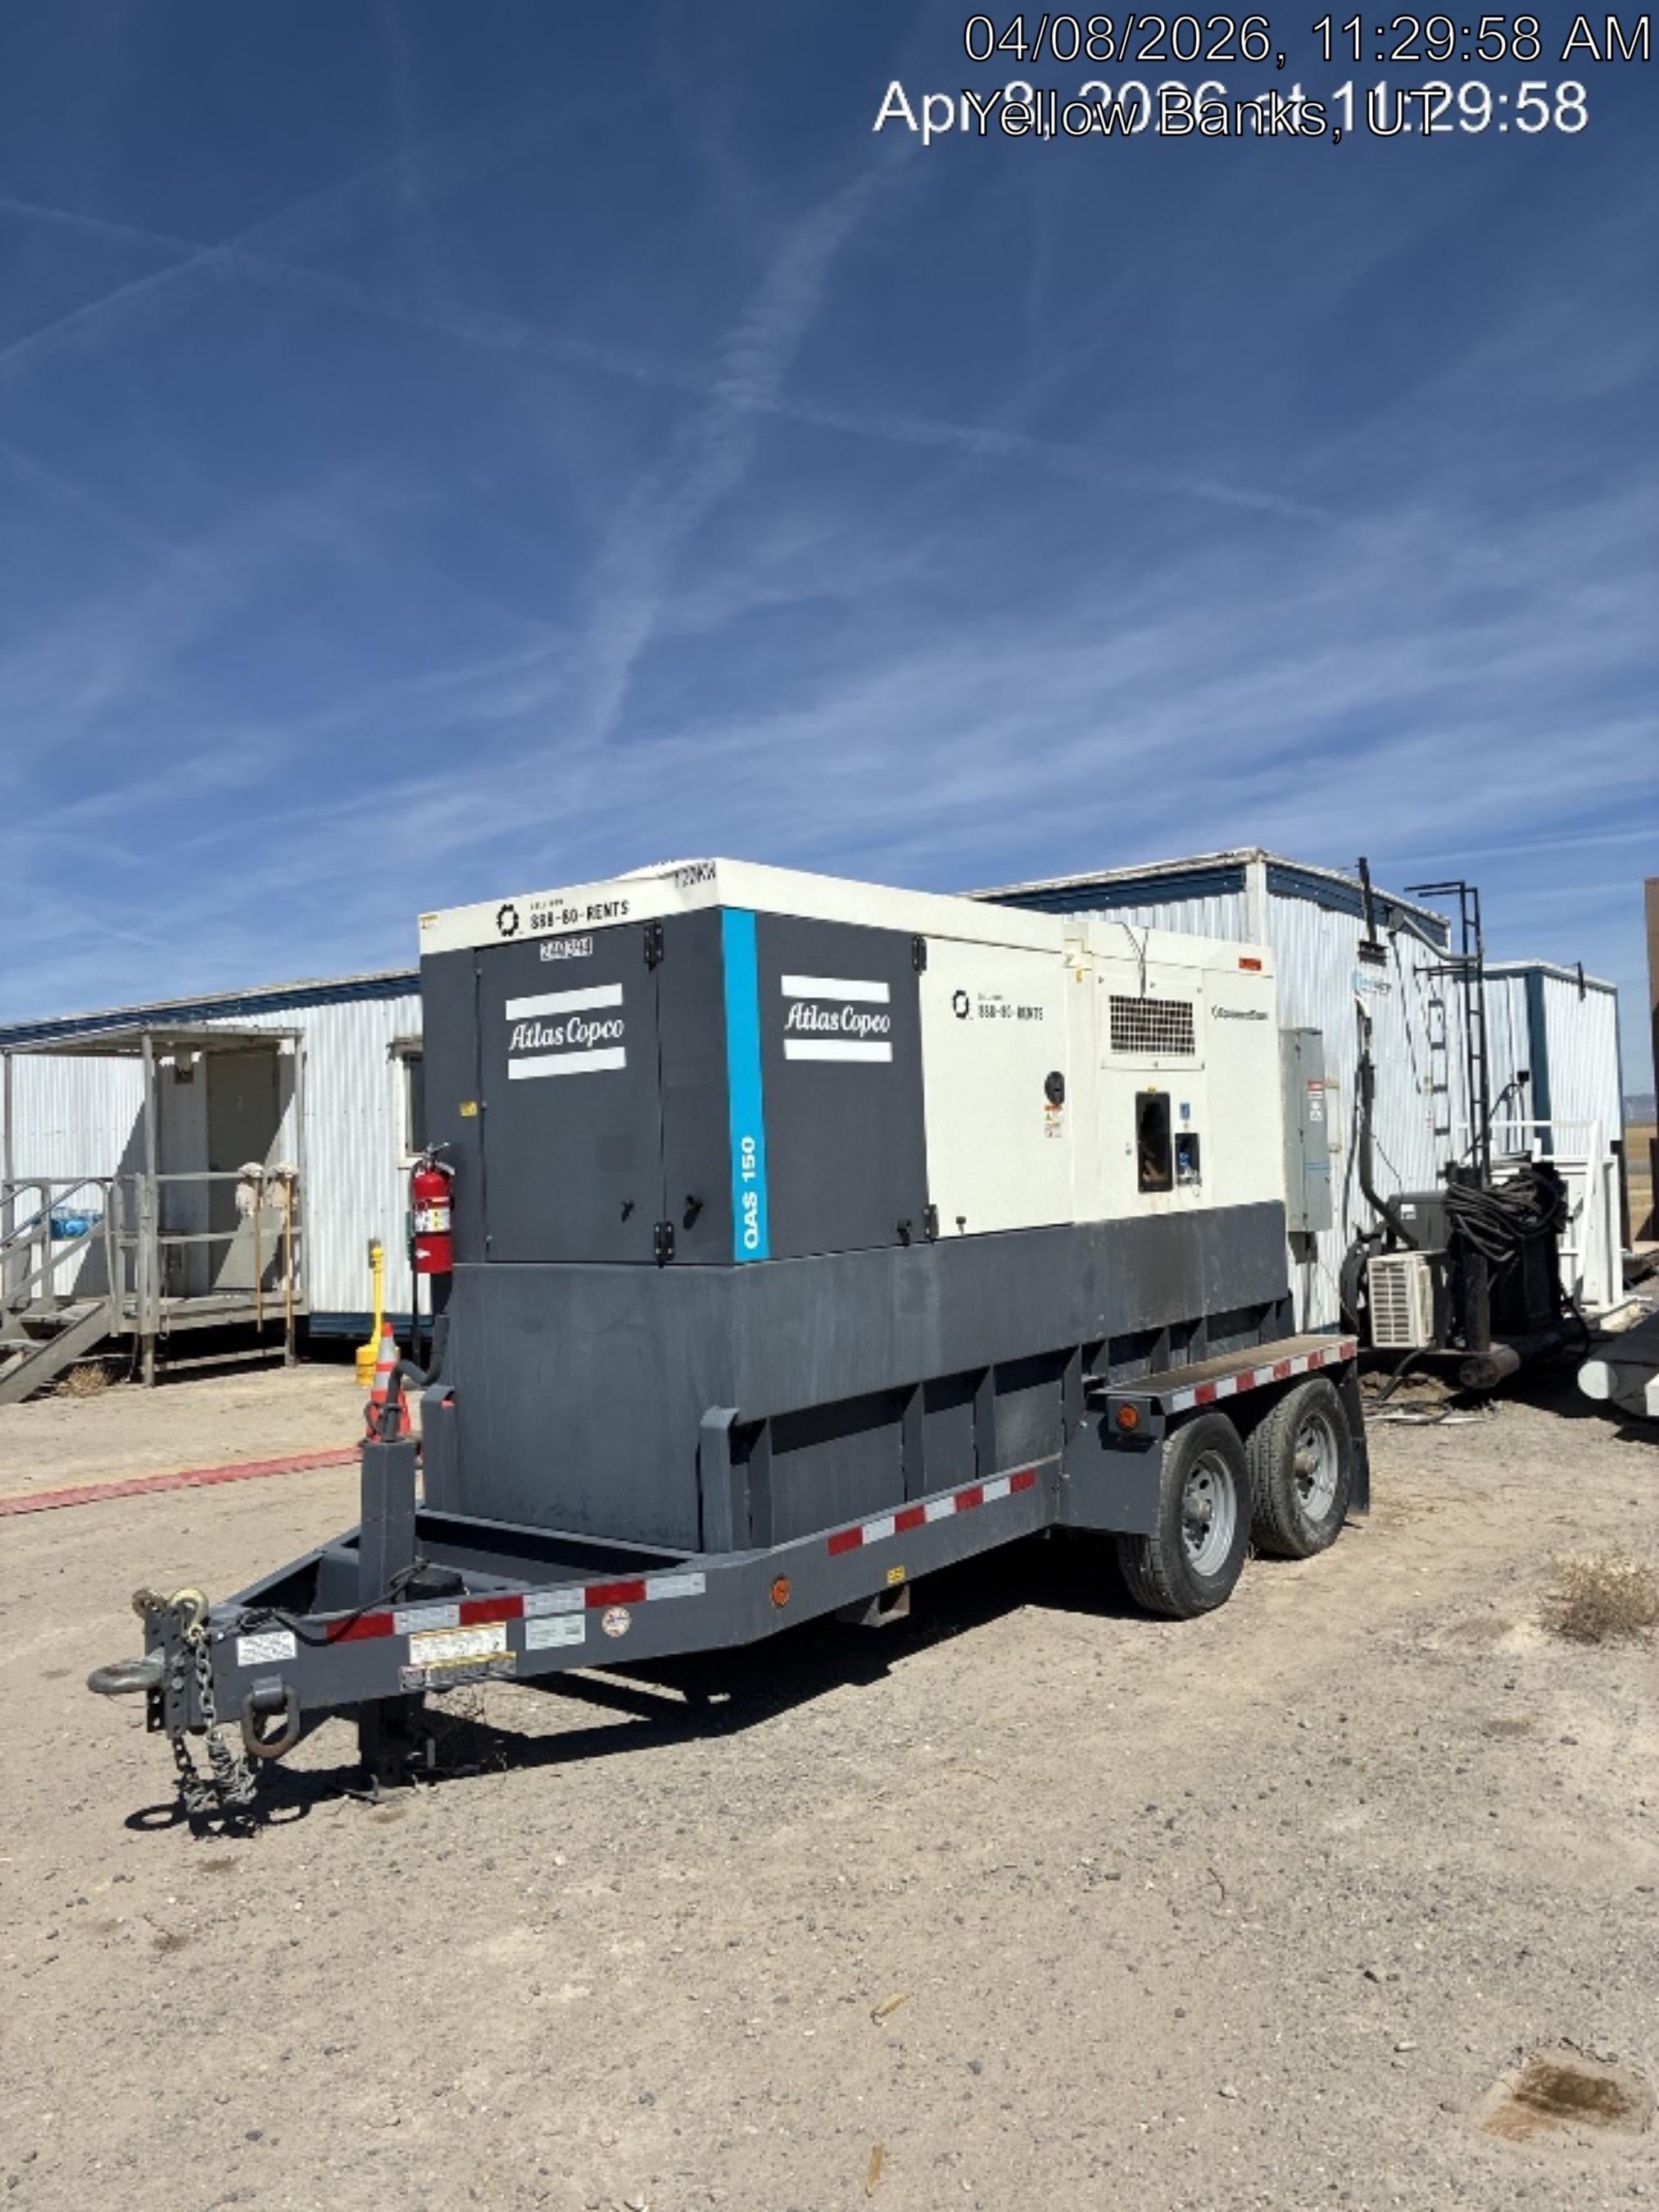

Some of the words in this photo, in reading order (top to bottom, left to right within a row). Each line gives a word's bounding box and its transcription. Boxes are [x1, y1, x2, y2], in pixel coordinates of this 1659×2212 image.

[508, 1022, 564, 1052] Atlas
[566, 1017, 625, 1048] Copco
[783, 1002, 840, 1031] Atlas
[840, 1004, 891, 1038] Copco
[741, 1135, 756, 1183] 150
[743, 1191, 759, 1250] QAS
